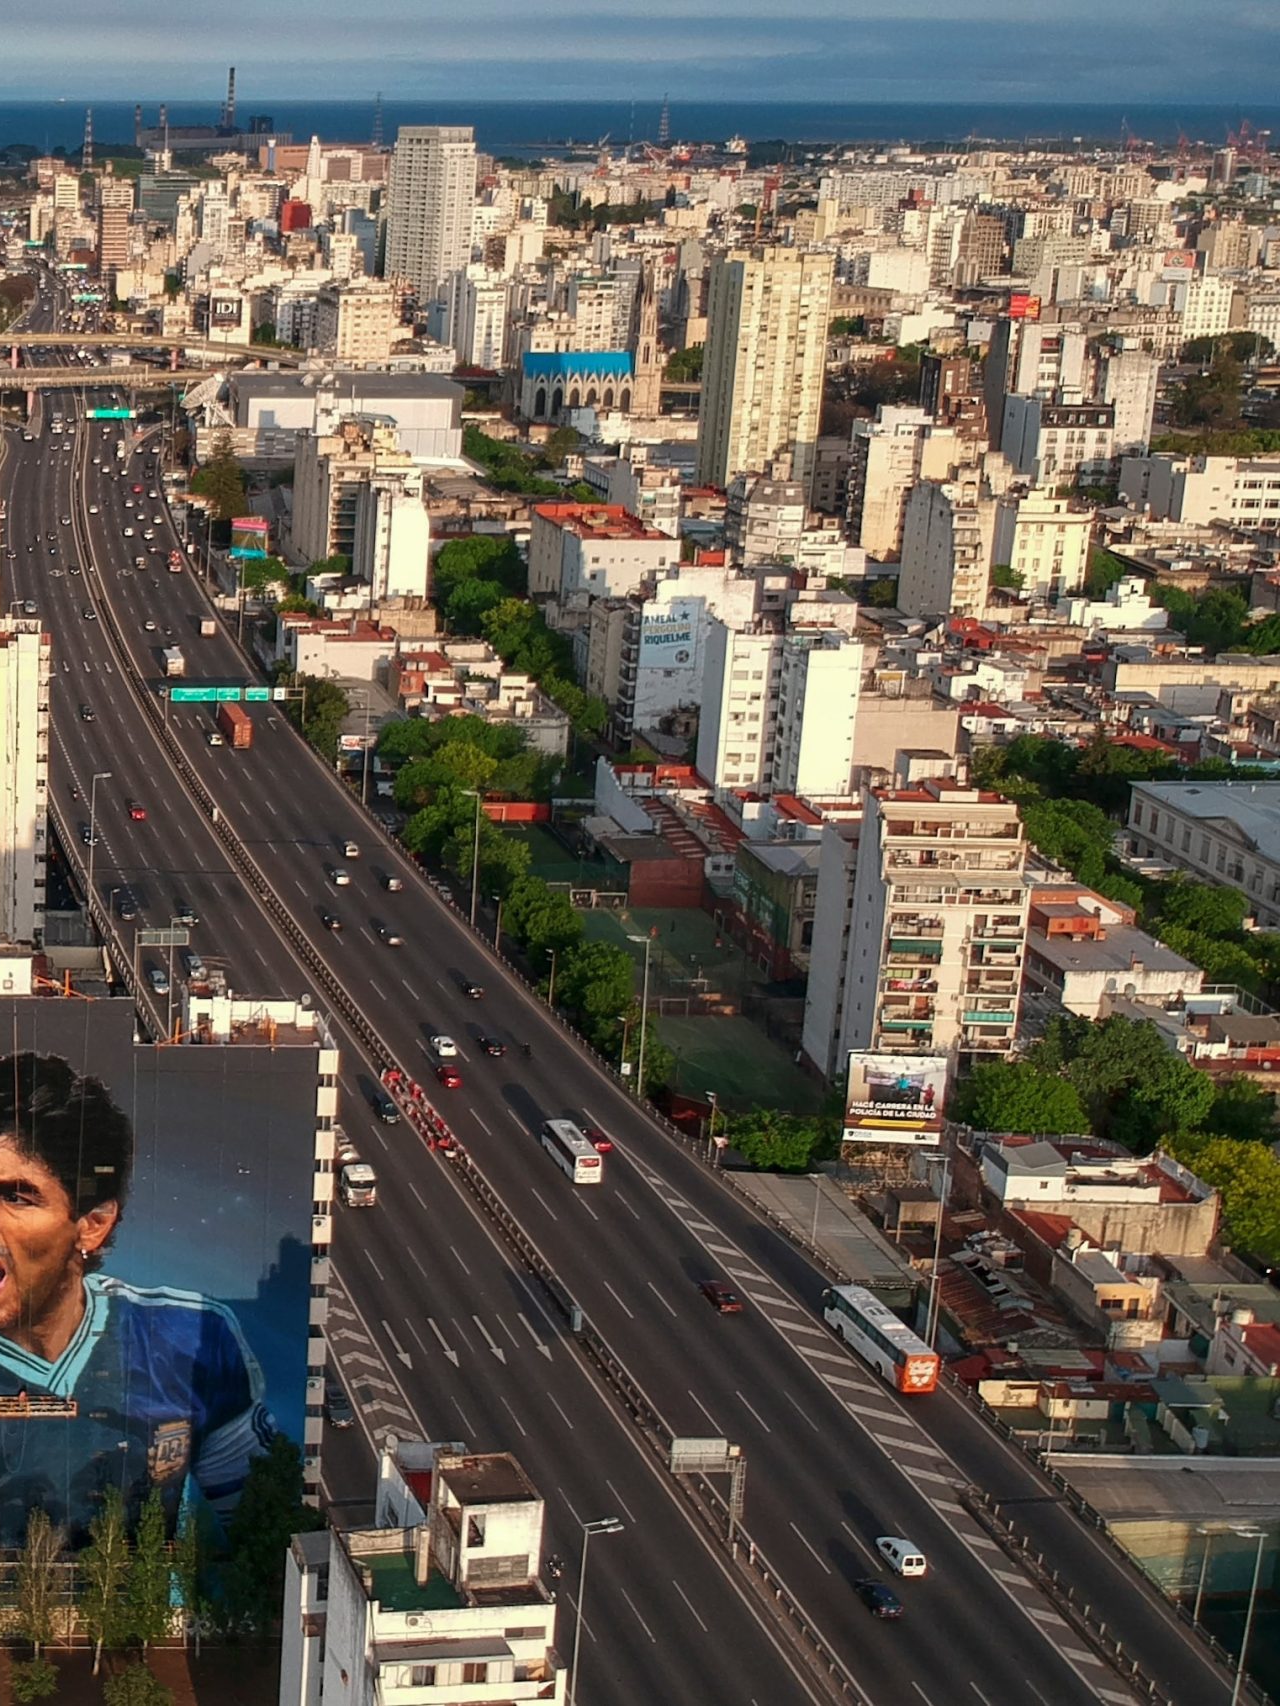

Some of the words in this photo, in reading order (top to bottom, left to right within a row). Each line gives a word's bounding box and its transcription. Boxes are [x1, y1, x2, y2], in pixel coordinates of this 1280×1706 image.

[216, 302, 237, 314] IDI
[644, 613, 677, 624] AMEAL
[644, 632, 691, 645] RIQUELME
[852, 1100, 874, 1108] HACÉ
[875, 1102, 912, 1110] CARRERA
[913, 1103, 924, 1111] EN
[925, 1104, 935, 1112] LA
[849, 1108, 882, 1116] POLICÍA
[895, 1110, 905, 1118] LA
[906, 1111, 937, 1119] CIUDAD
